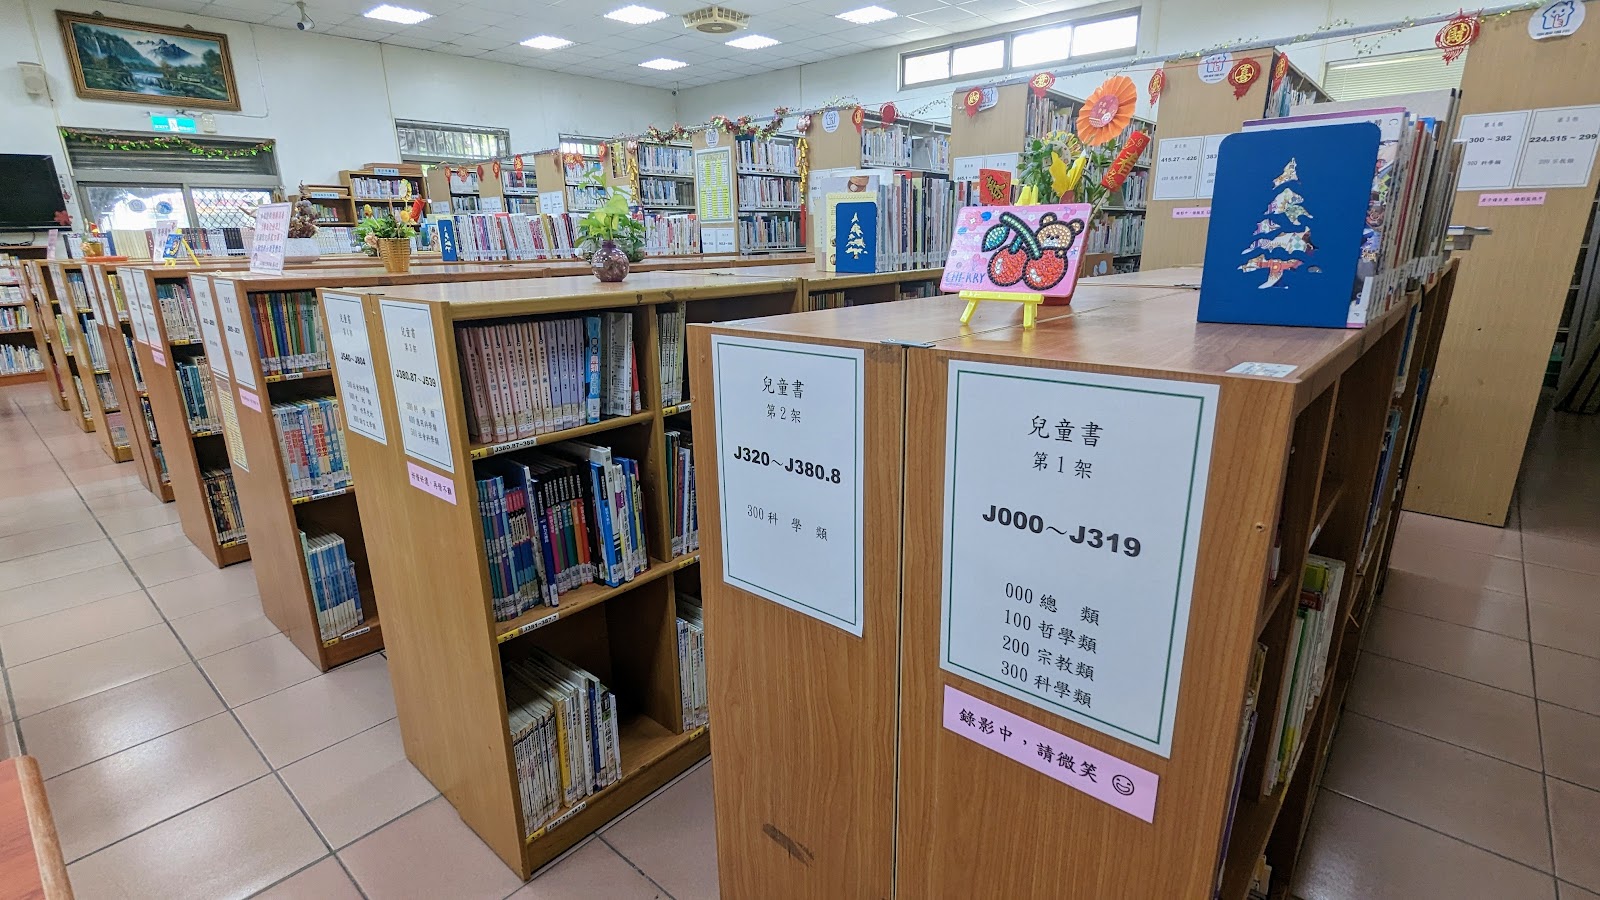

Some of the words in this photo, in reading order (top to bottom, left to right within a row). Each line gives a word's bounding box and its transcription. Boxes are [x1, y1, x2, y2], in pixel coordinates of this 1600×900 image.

[1529, 135, 1567, 143] 224.515
[401, 326, 416, 339] 兒童書
[763, 376, 804, 399] 兒童書
[767, 404, 800, 423] 第2架
[1028, 416, 1103, 447] 兒童書
[734, 446, 840, 484] J320～J380.8
[1033, 452, 1092, 479] 第1架
[747, 504, 765, 523] 300
[983, 505, 1141, 557] J000～J319
[1006, 583, 1032, 603] 000
[1005, 610, 1030, 630] 100
[1039, 620, 1097, 655] 哲學類
[1003, 636, 1029, 656] 200
[1037, 648, 1095, 682] 宗教類
[1001, 661, 1028, 683] 300
[1034, 674, 1092, 709] 科學類
[959, 708, 1099, 784] 錄影中，請微笑
